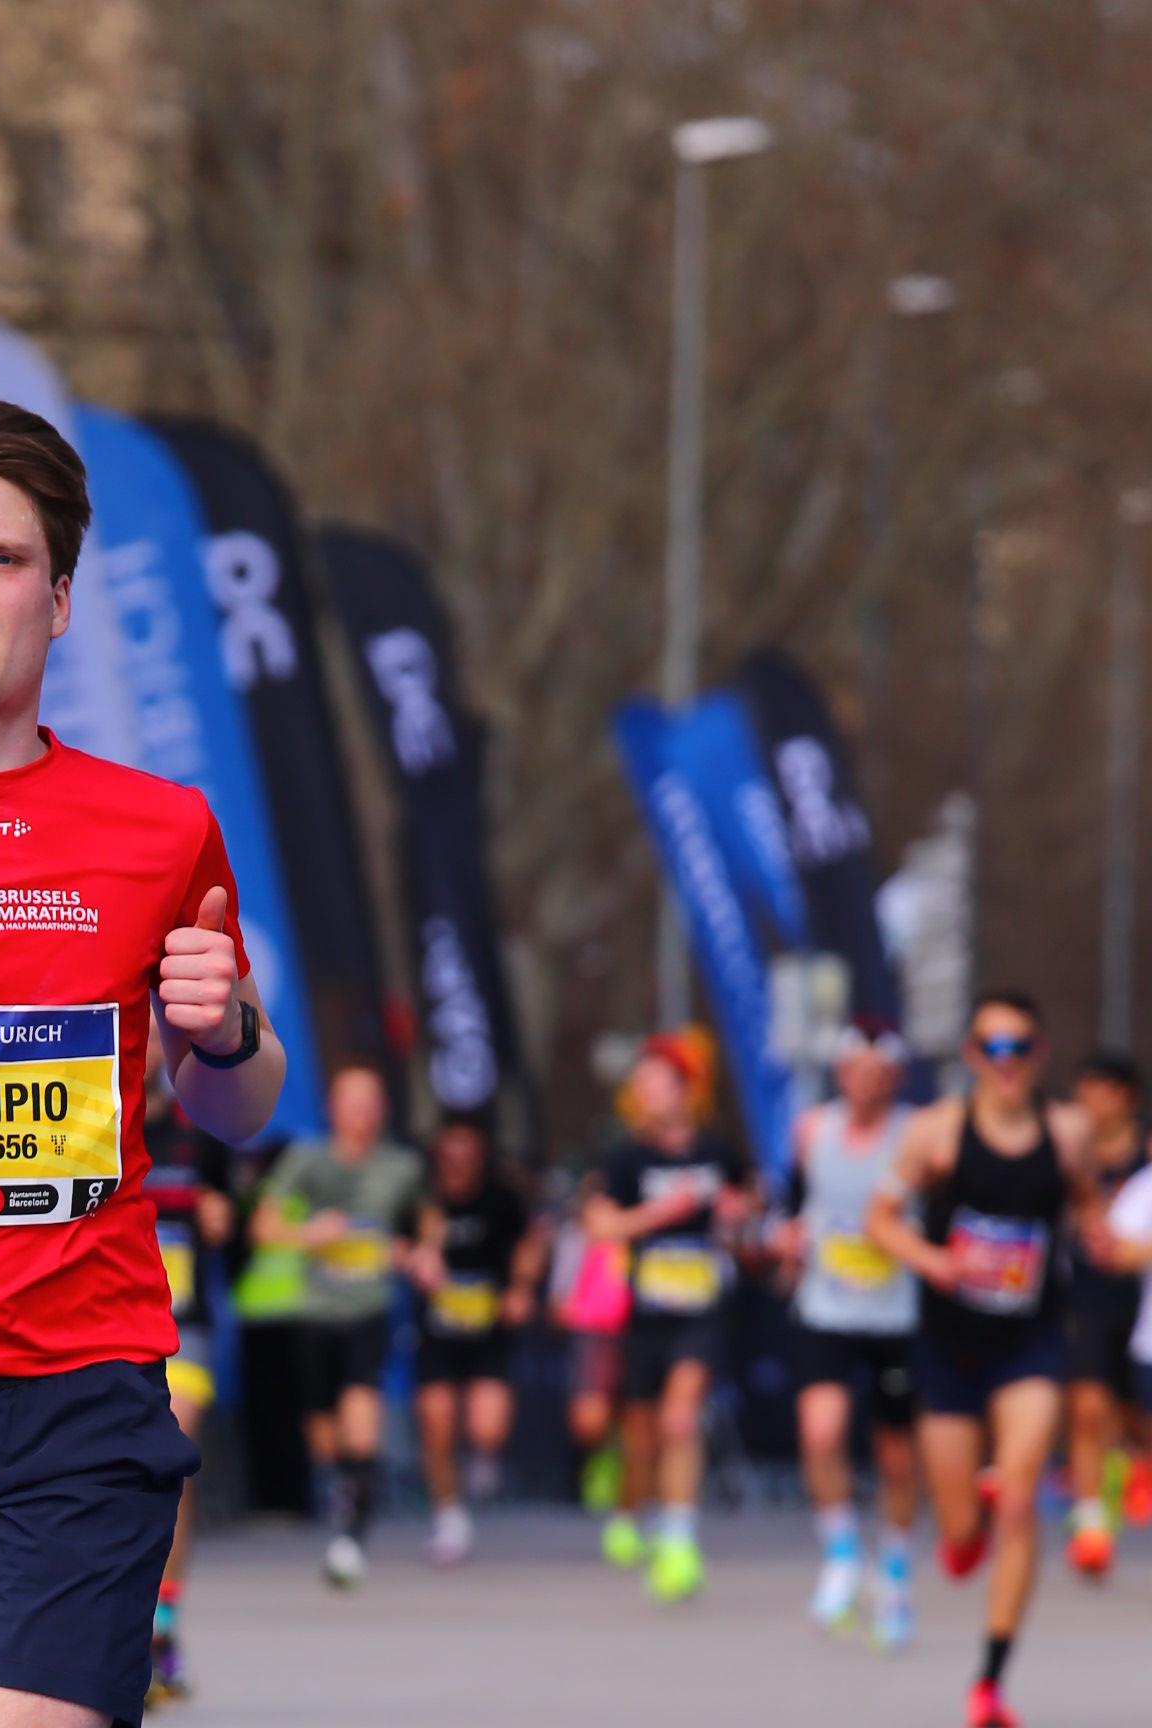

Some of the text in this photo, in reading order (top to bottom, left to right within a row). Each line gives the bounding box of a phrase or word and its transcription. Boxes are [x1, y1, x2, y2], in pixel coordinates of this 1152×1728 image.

[5, 922, 27, 930] HALF
[28, 922, 76, 932] MARATHON
[77, 923, 98, 933] 2024
[9, 1192, 42, 1200] Ajuntament
[9, 1198, 49, 1208] Barcelona
